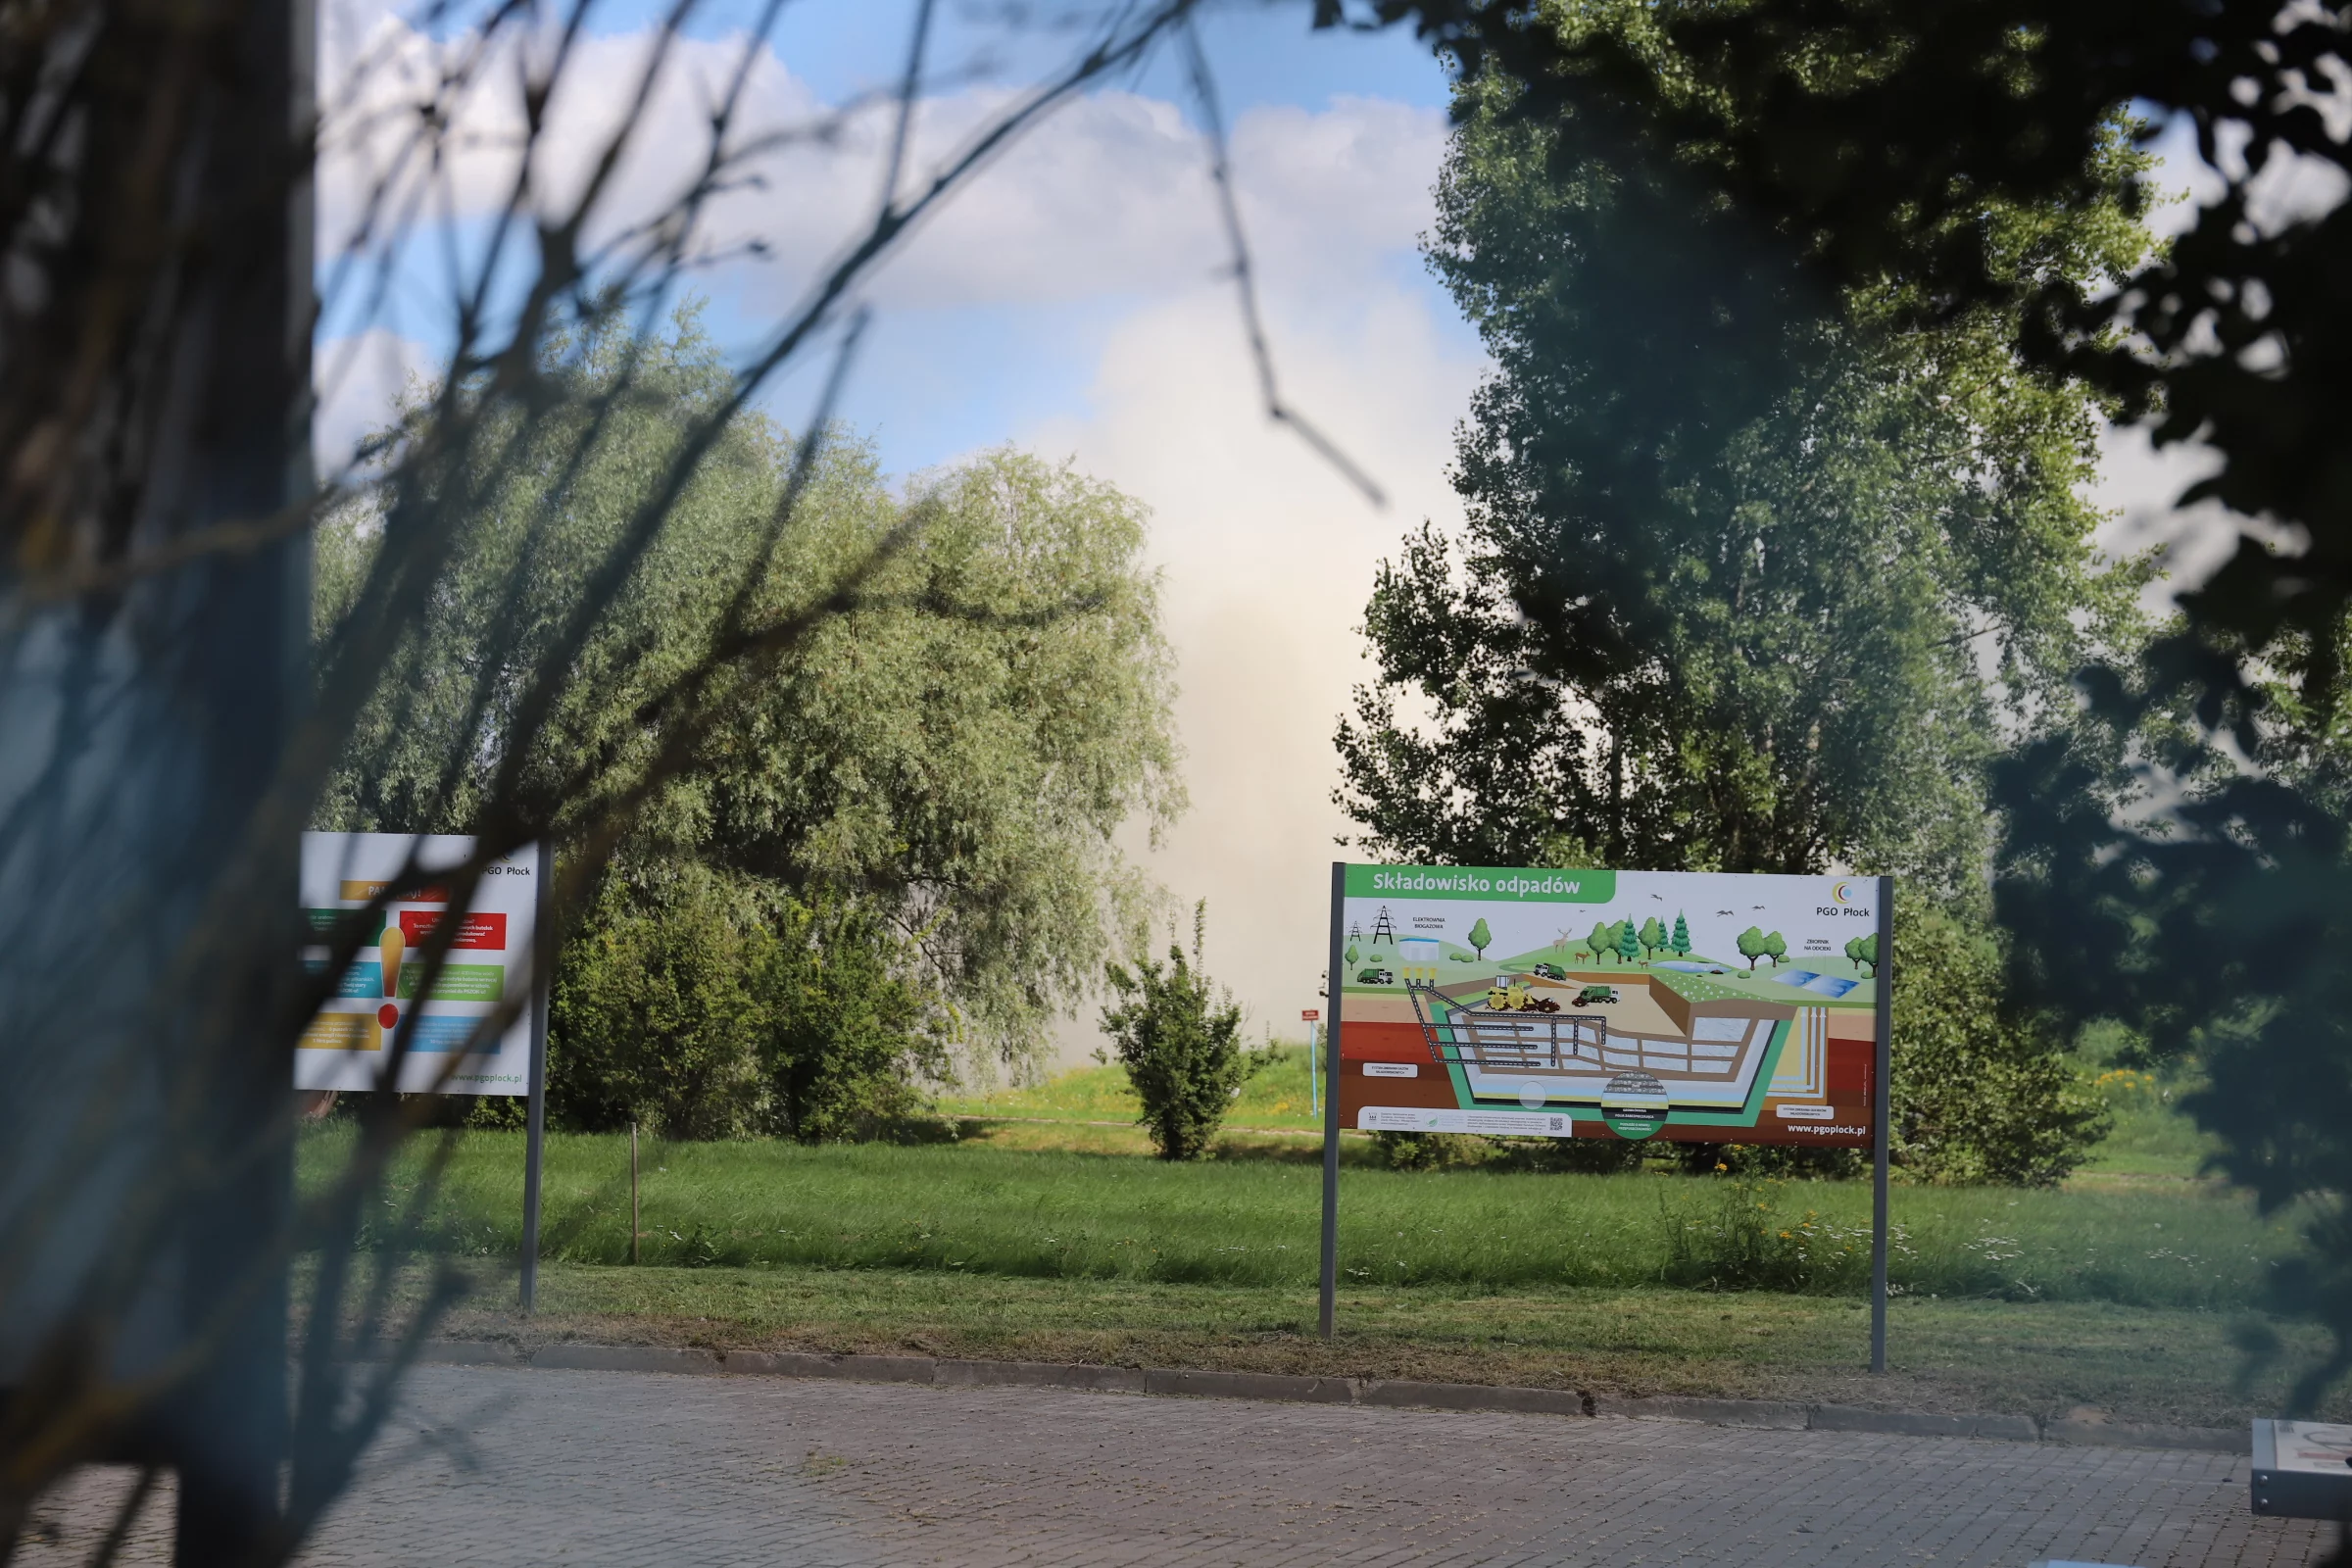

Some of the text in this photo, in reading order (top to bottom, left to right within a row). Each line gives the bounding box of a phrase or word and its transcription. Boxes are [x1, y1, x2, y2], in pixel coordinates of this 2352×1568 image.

[1373, 872, 1581, 898] Składowisko odpadów
[1816, 906, 1870, 917] PGO Płock
[1788, 1124, 1867, 1137] www.pgoplock.pl
